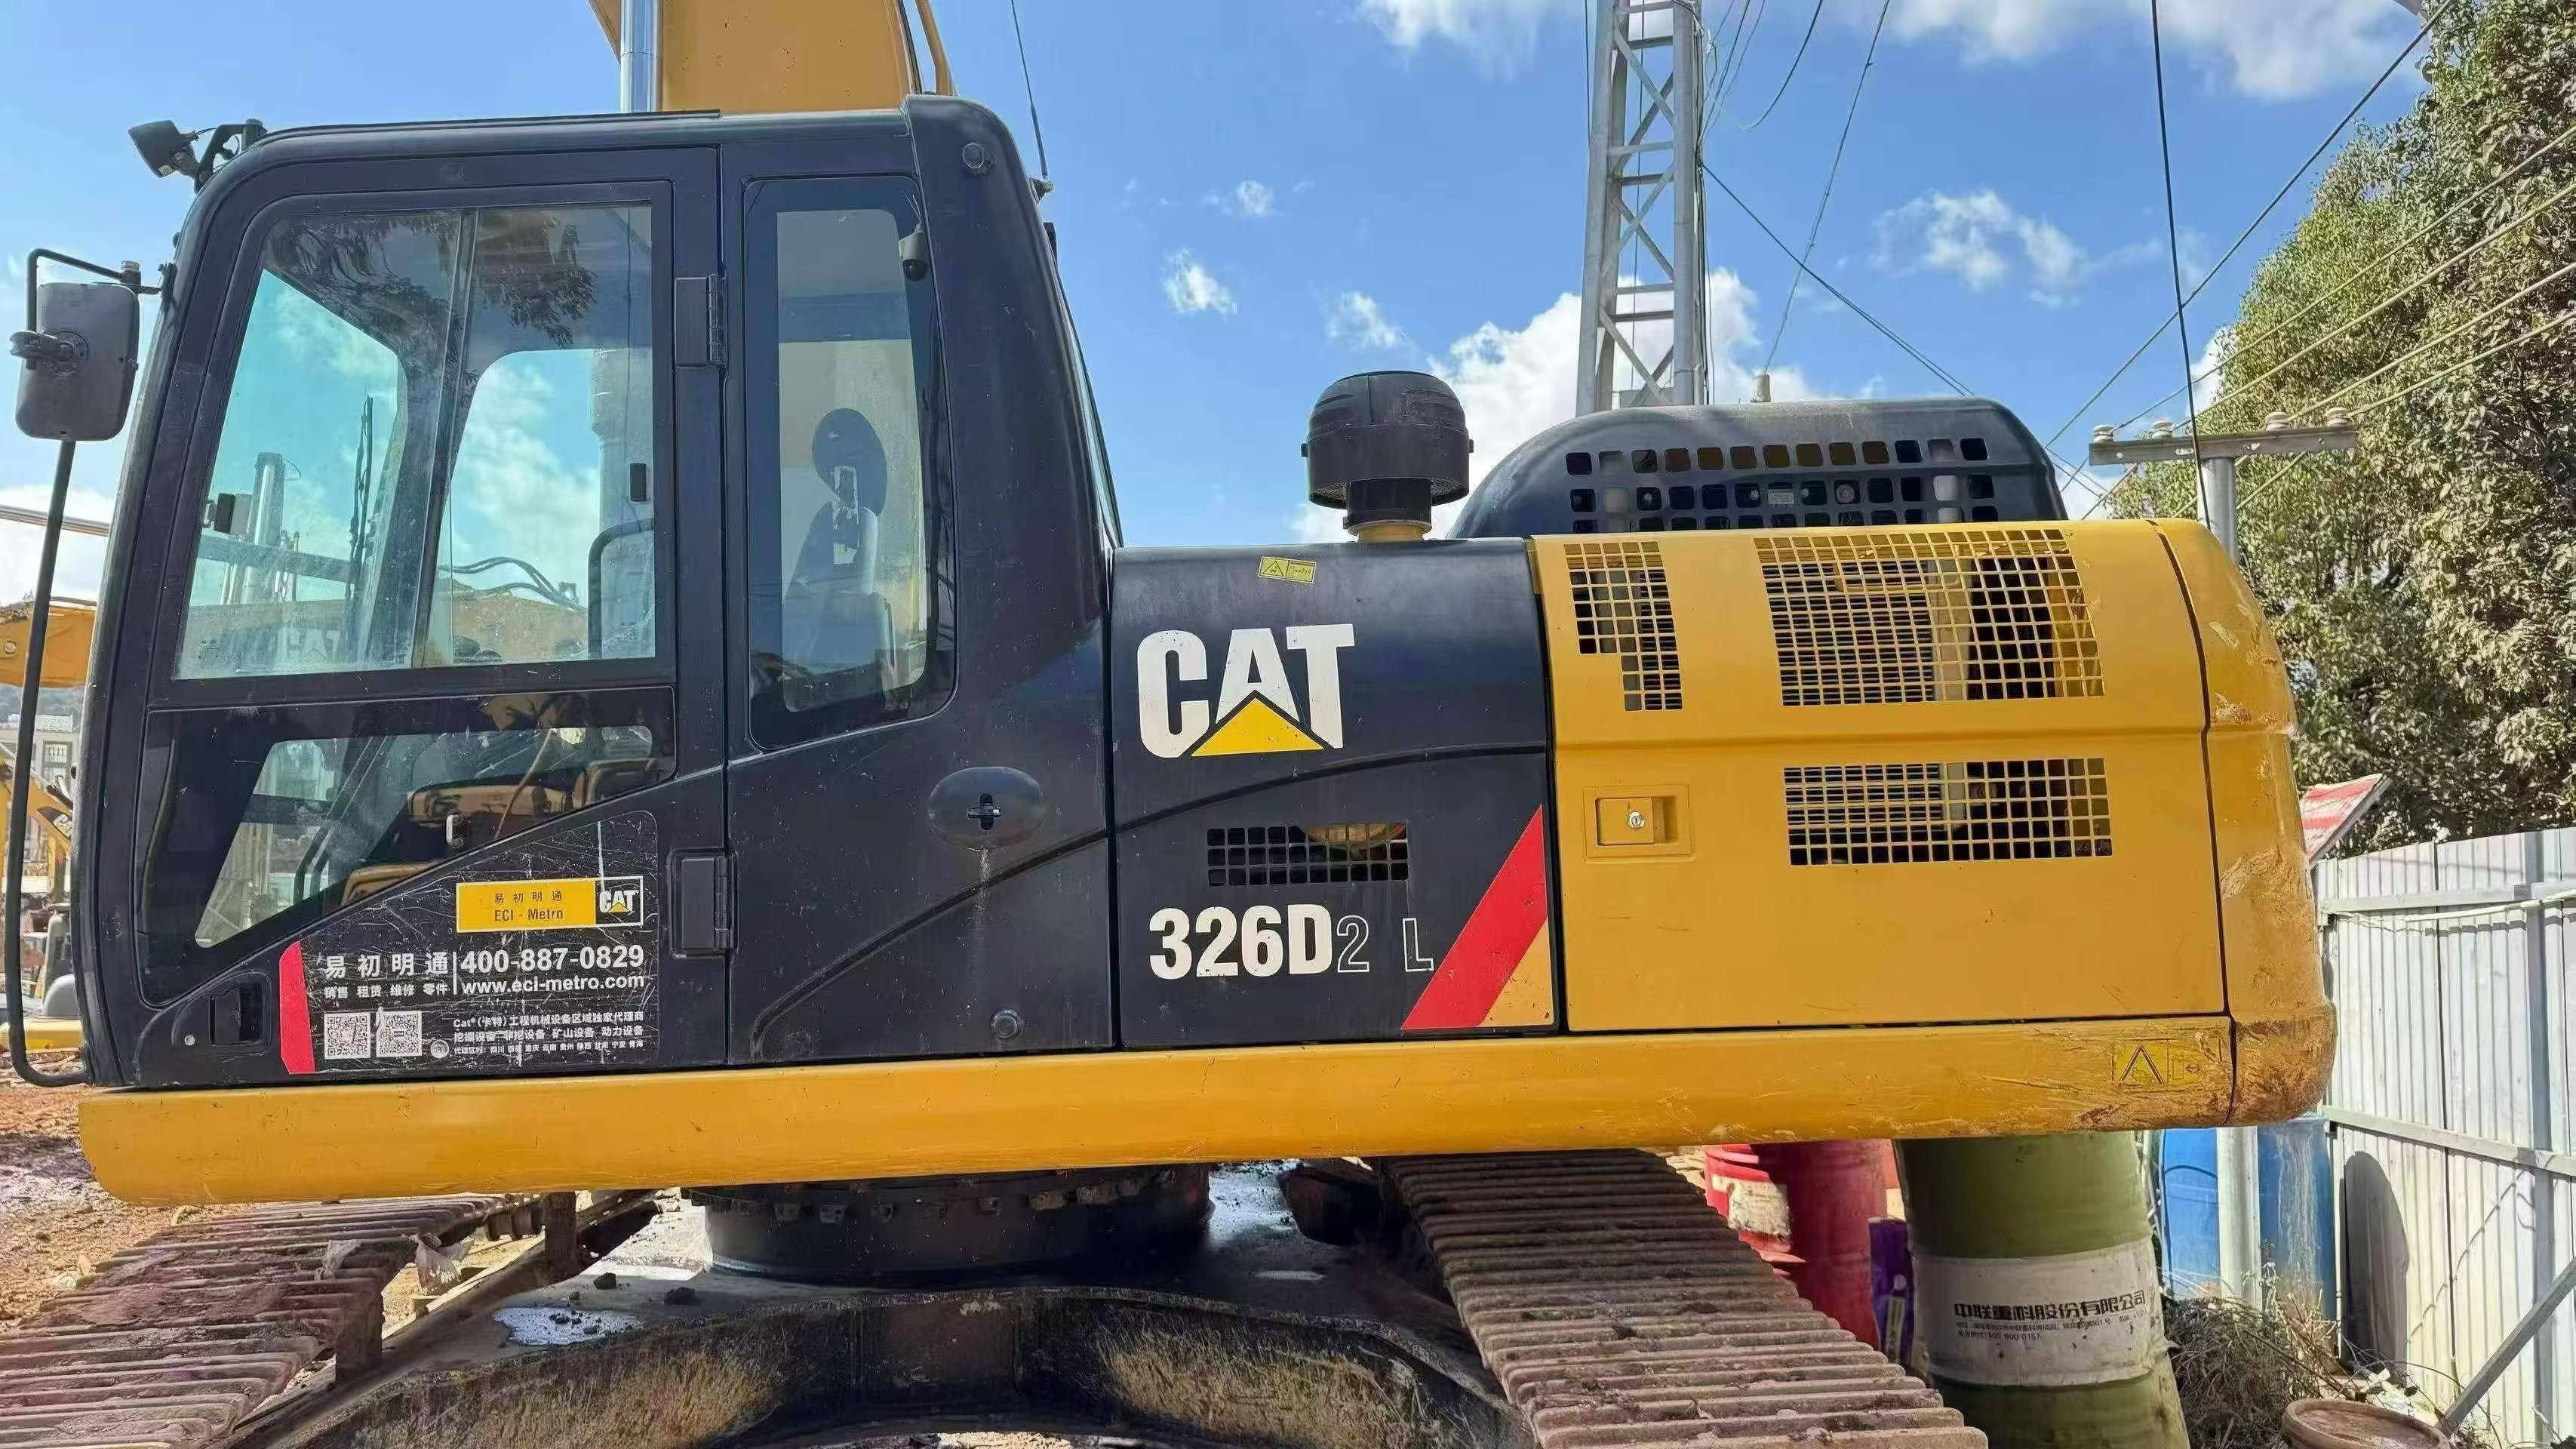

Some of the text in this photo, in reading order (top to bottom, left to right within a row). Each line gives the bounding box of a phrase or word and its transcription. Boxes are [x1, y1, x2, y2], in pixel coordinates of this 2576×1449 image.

[1136, 623, 1354, 758] CAT
[494, 890, 563, 904] 易初明通
[599, 890, 637, 912] CAT
[494, 909, 514, 921] ECI
[528, 908, 564, 920] Metro
[1402, 917, 1434, 972] L
[324, 952, 448, 979] 易初明通
[460, 944, 644, 974] 400-887-0829
[324, 986, 349, 999] 销售
[389, 984, 415, 997] 维修
[423, 983, 448, 995] 零件
[463, 974, 644, 994] www.eci-metro.com
[552, 1026, 595, 1038] 矿山设备
[601, 1025, 643, 1036] 动力设备
[1954, 1290, 2145, 1321] 中联重科股份有限公司
